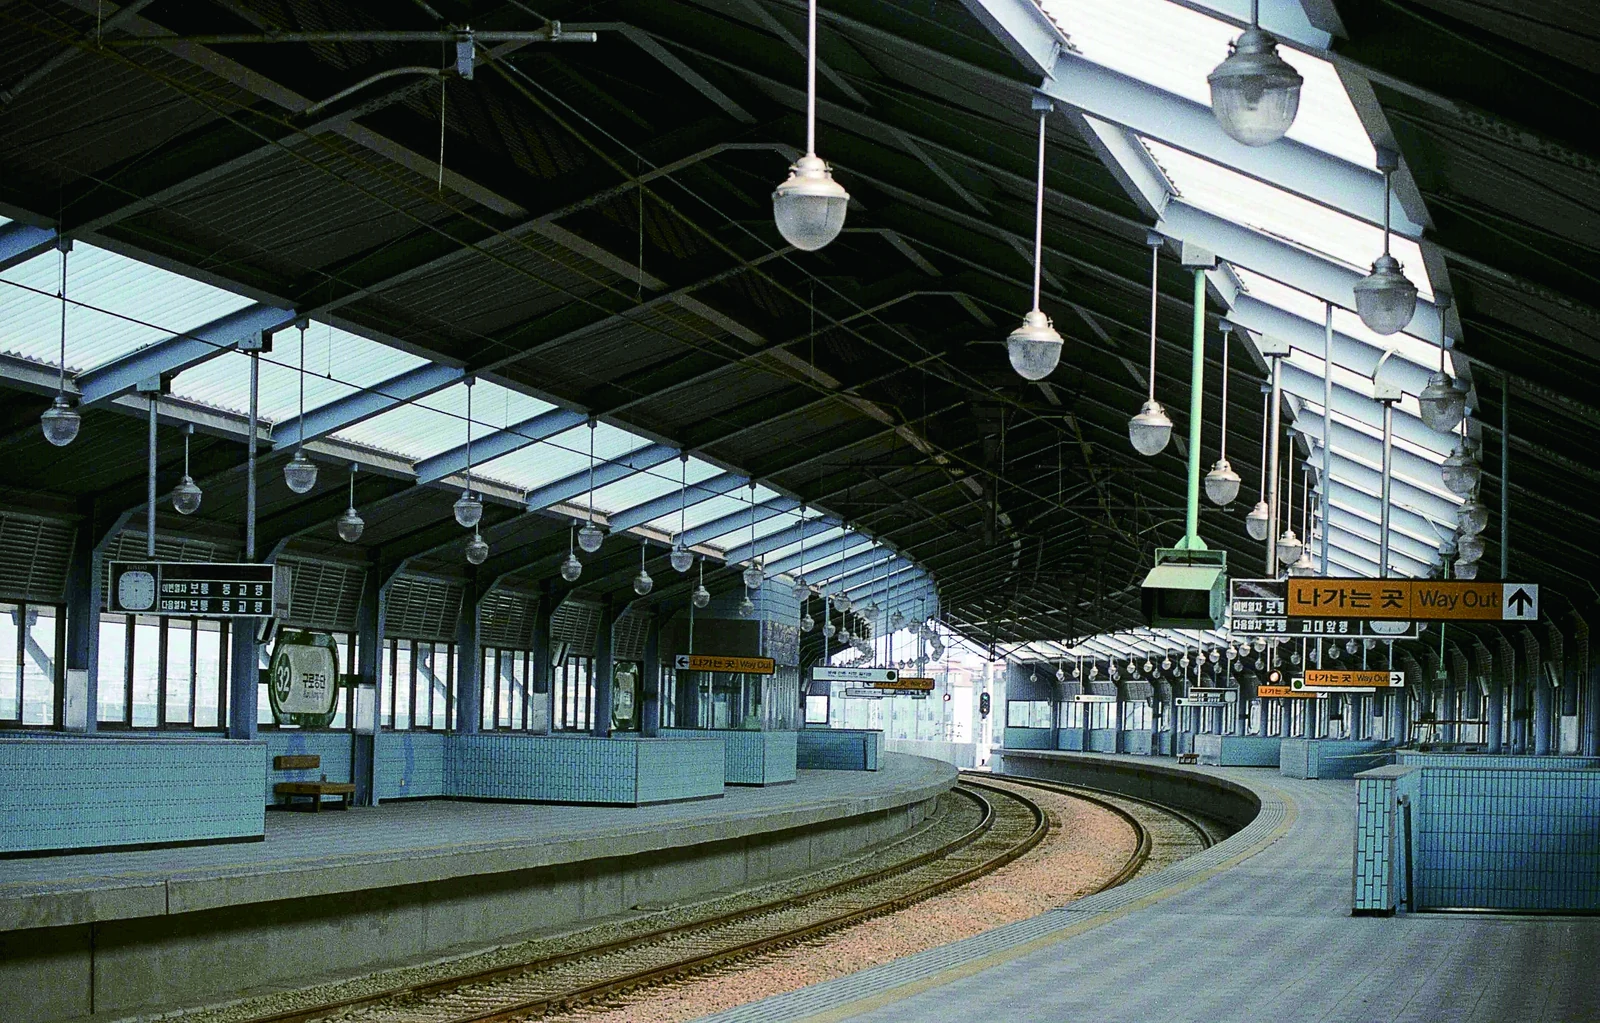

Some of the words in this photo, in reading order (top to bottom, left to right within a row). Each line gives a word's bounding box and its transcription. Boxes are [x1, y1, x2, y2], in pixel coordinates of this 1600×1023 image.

[1296, 588, 1373, 608] 나가는
[1381, 588, 1405, 608] 곳
[1418, 589, 1458, 610] Way
[1463, 590, 1498, 608] Out
[1232, 619, 1262, 631] 다음열차
[692, 658, 723, 668] 나가는
[724, 660, 735, 668] 곳
[739, 660, 757, 670] Way
[757, 660, 772, 669] Out
[276, 666, 290, 692] 32
[1308, 673, 1339, 683] 나가는
[1341, 674, 1352, 683] 곳
[1356, 673, 1373, 684] Way
[1373, 673, 1389, 683] Out
